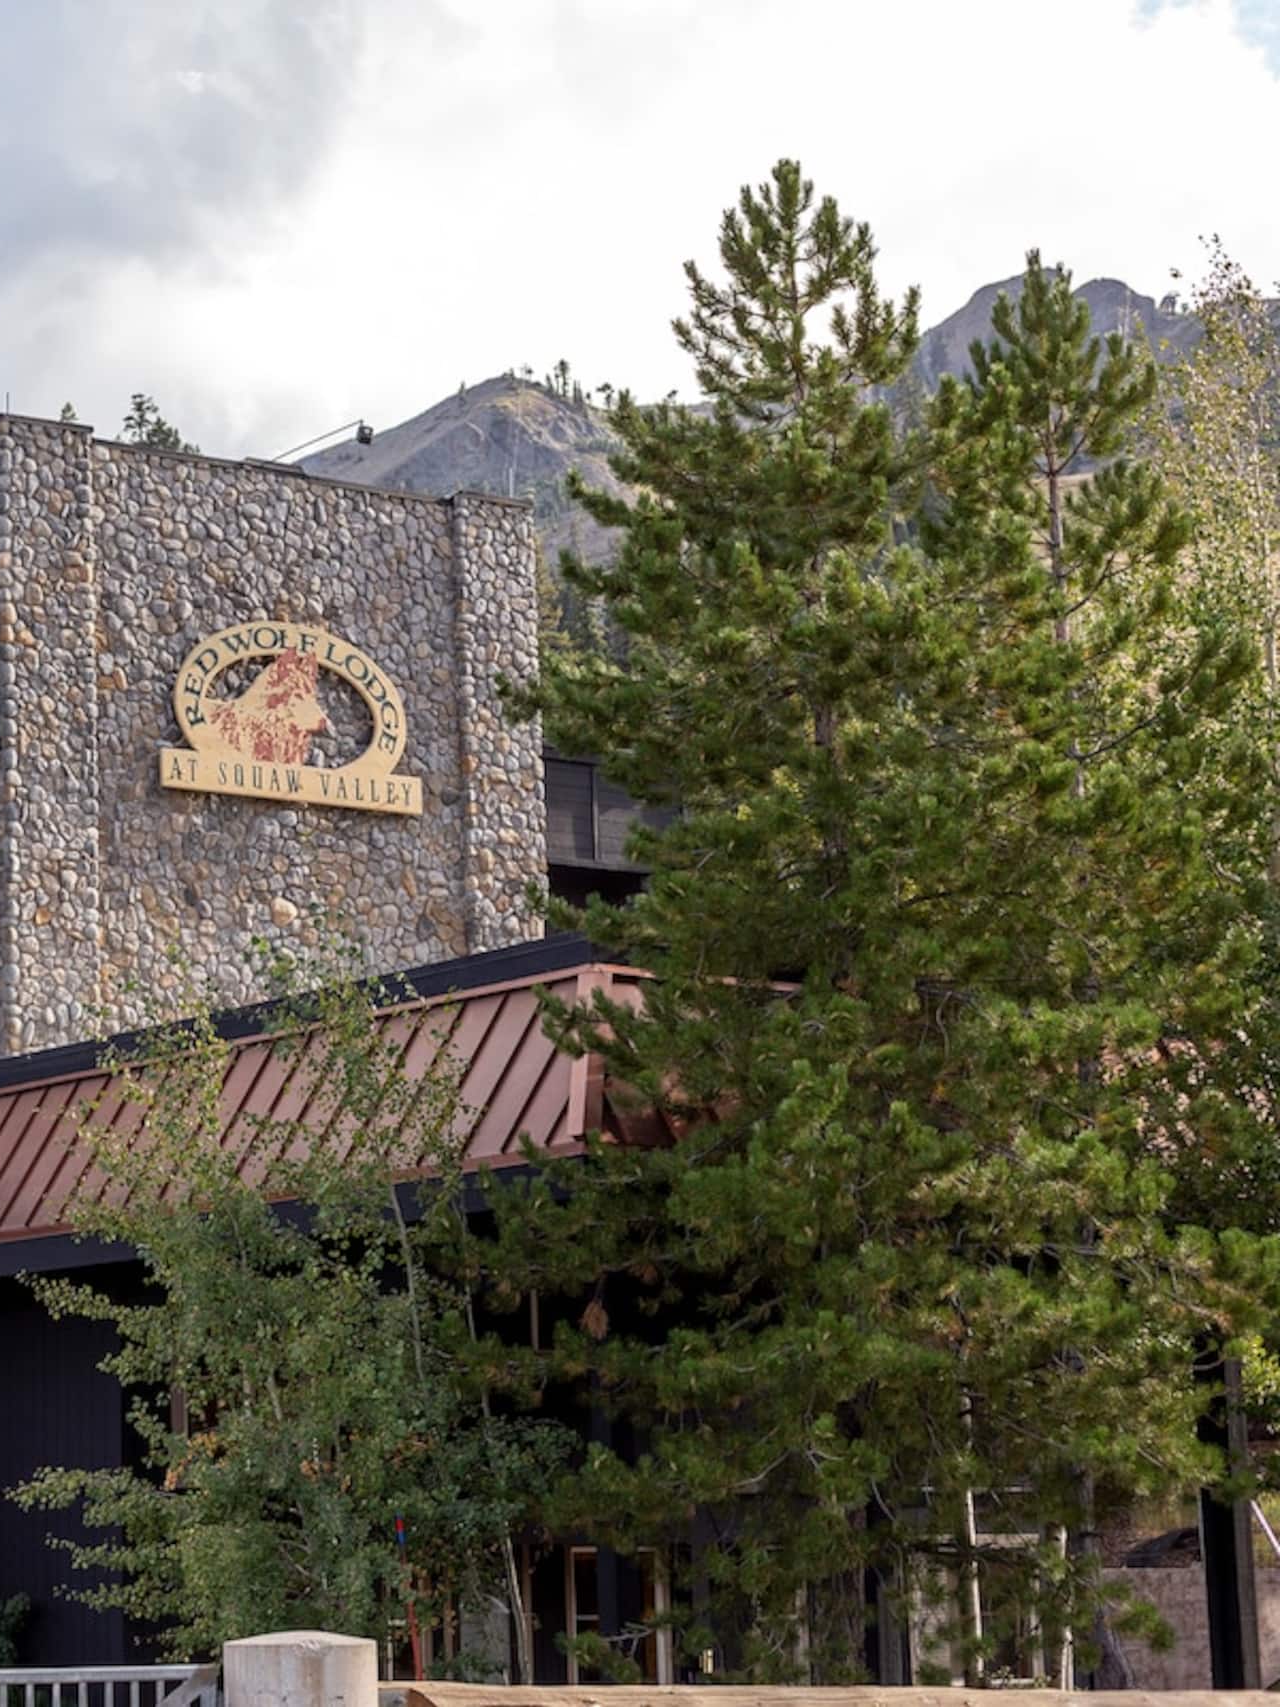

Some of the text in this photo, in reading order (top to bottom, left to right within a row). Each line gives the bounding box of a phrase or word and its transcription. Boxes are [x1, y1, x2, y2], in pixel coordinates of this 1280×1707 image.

[184, 627, 399, 755] RED WOLF LODGE
[170, 757, 414, 806] AT SQUAW VALLEY
